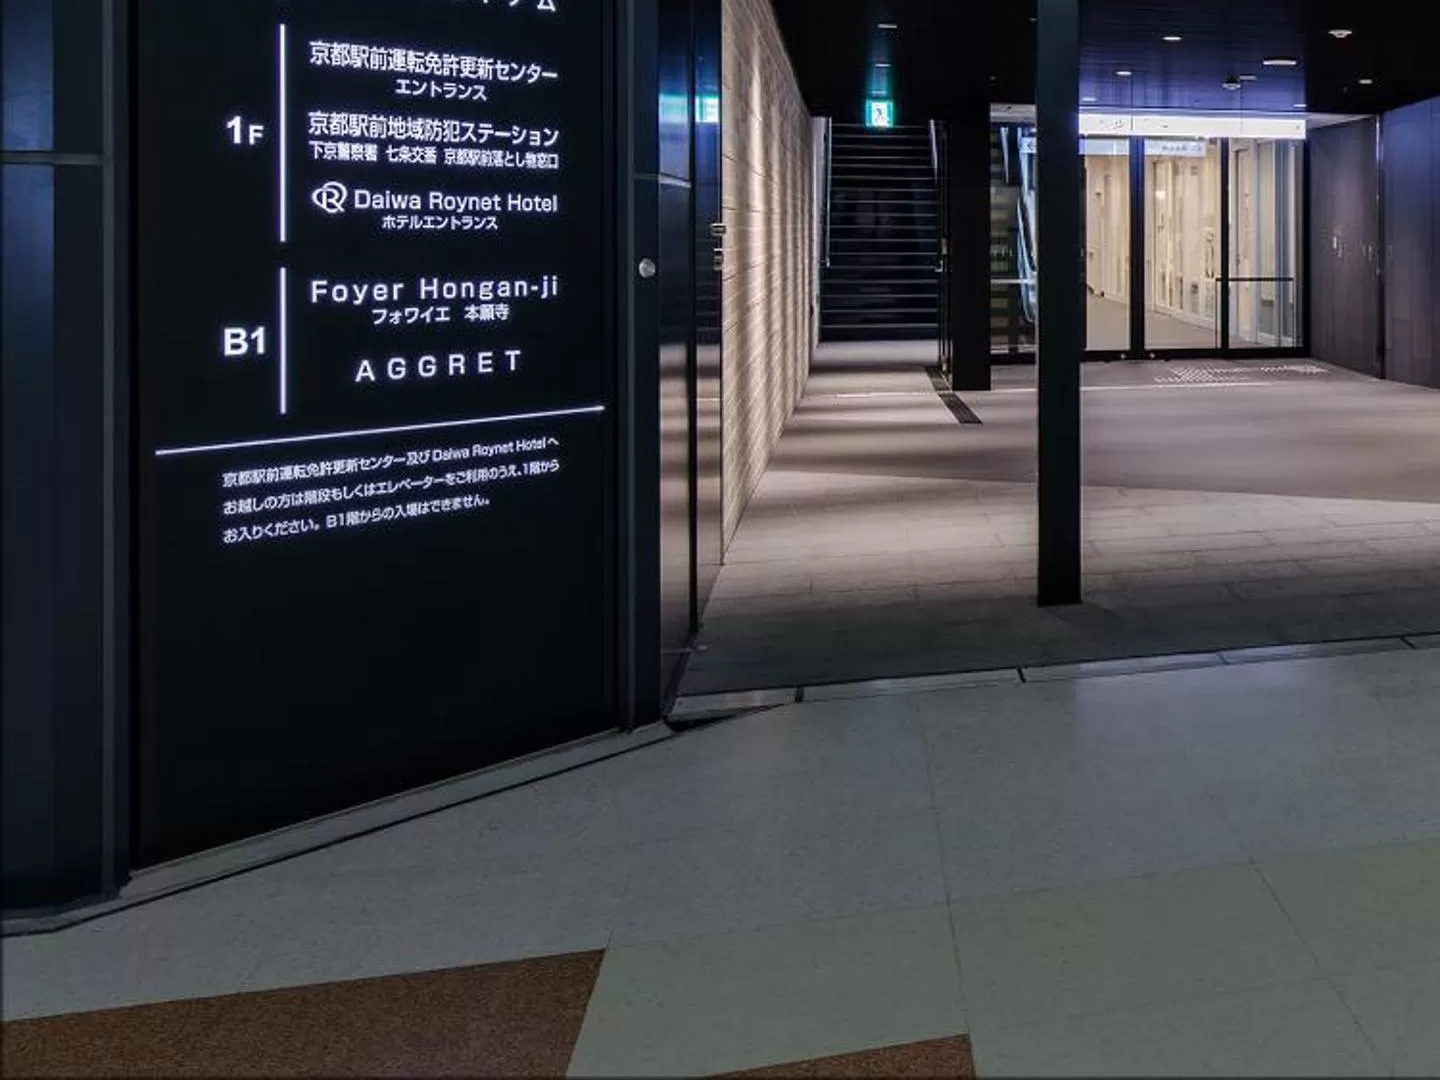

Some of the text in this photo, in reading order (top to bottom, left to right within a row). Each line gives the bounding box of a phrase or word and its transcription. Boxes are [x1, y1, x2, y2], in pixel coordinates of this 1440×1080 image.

[309, 41, 559, 83] 京都駅前運転免許更新センター
[395, 79, 487, 102] エントランス
[225, 115, 264, 146] 1F
[308, 110, 559, 146] 京都駅前地域防犯ステーション
[354, 189, 422, 210] Daiwa
[429, 192, 502, 216] Roynet
[507, 194, 558, 213] Hotel
[382, 215, 498, 230] ホテルエントランス
[311, 275, 559, 306] Foyer Hongan-ji
[372, 303, 510, 325] フォワイエ 本願寺
[223, 326, 265, 356] B1
[355, 350, 522, 382] AGGRET
[433, 445, 470, 462] Daiwa
[473, 441, 514, 458] Roynet
